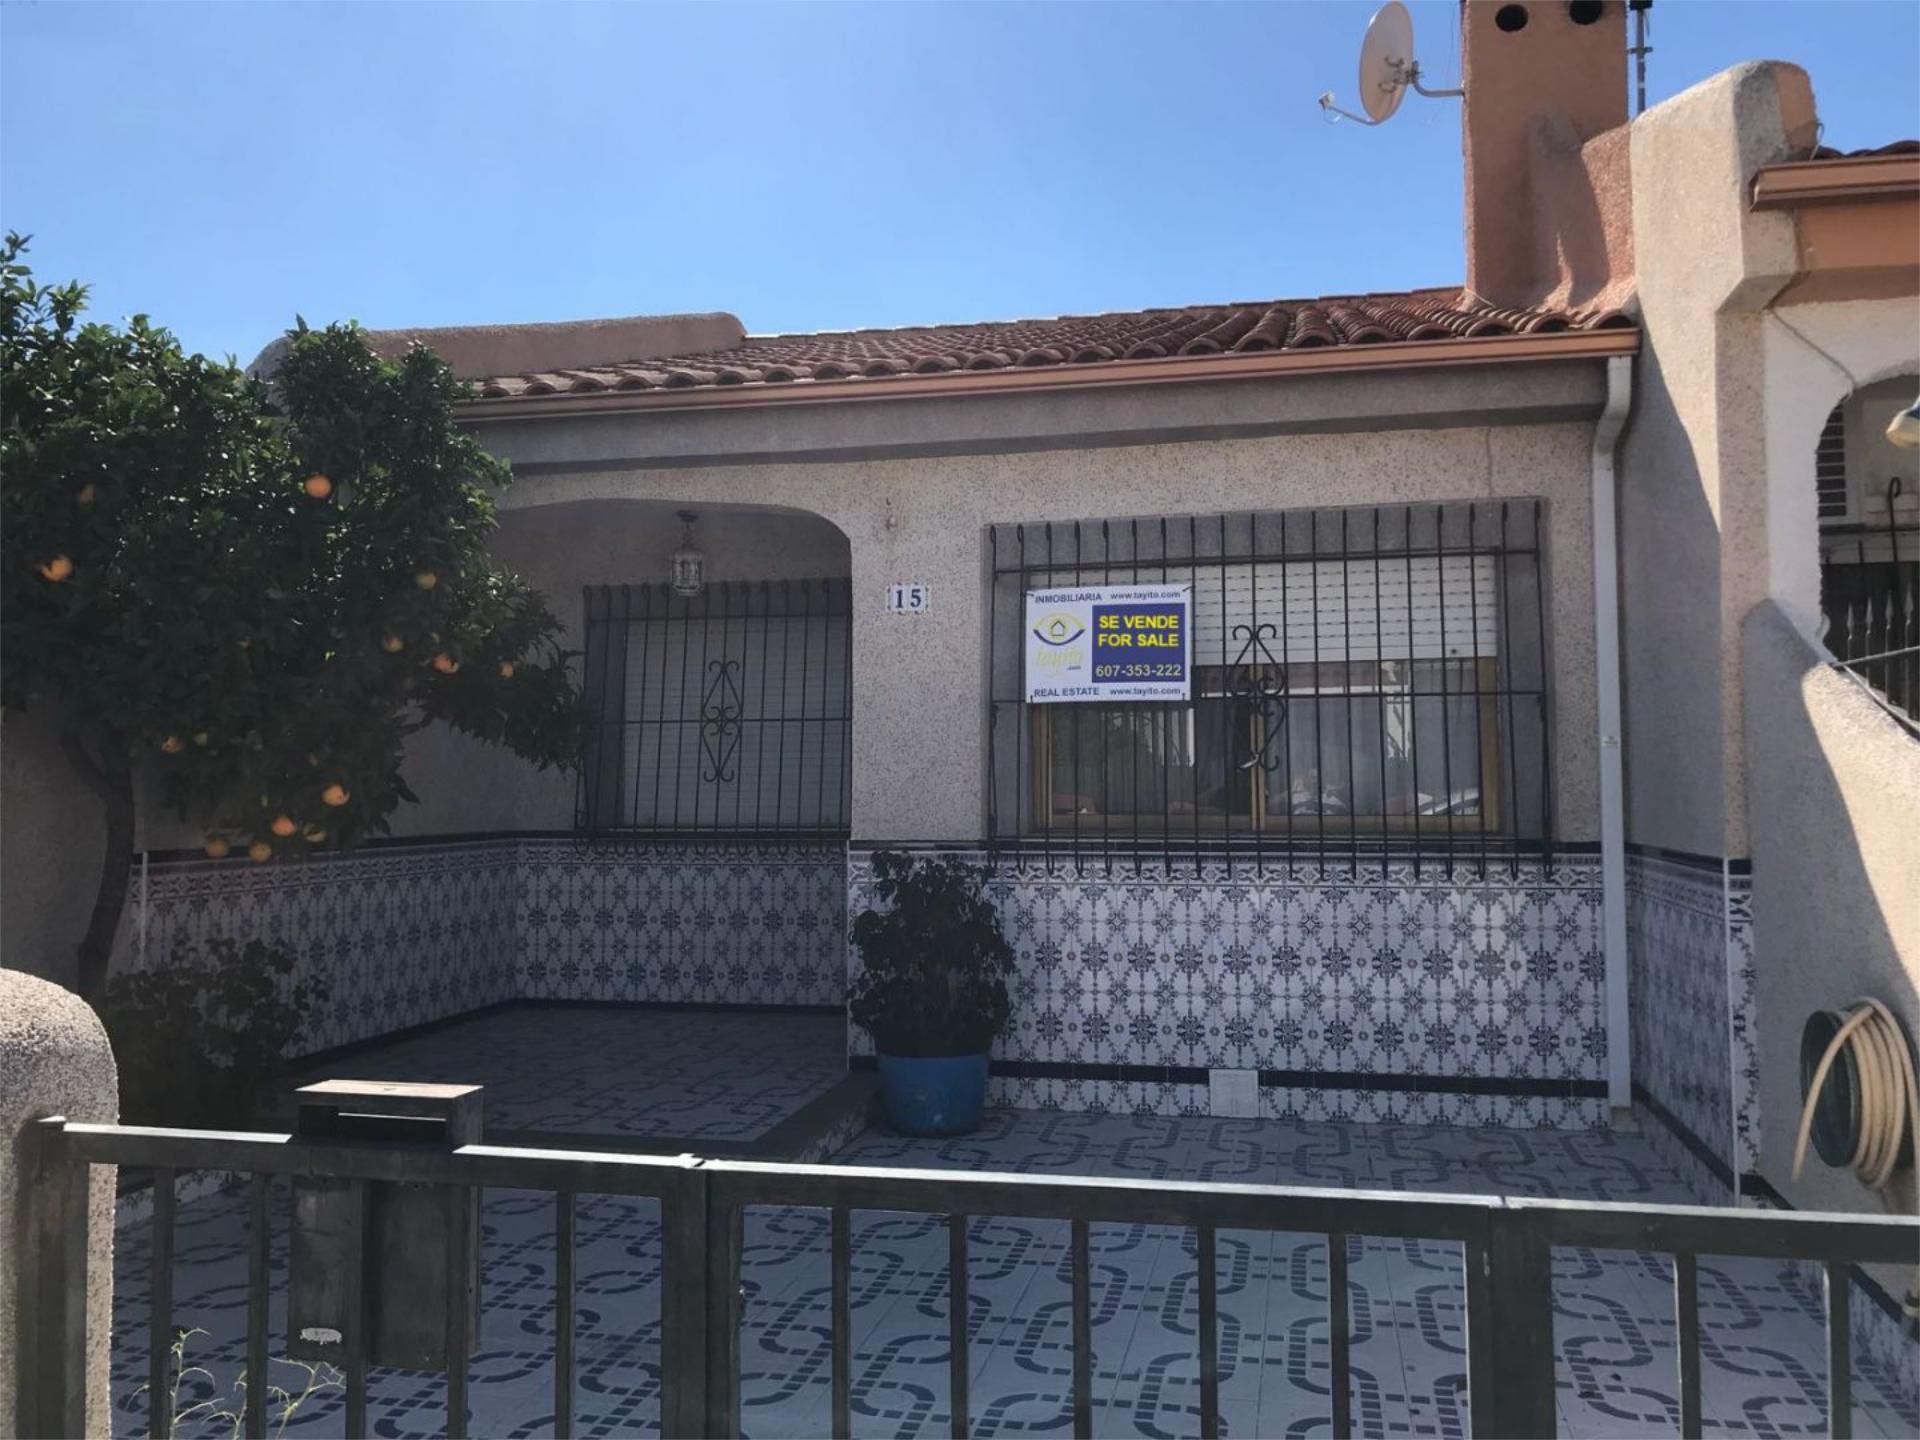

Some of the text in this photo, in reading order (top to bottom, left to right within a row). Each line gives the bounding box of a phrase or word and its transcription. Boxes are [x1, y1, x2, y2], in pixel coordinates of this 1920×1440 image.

[895, 589, 922, 608] 15
[1035, 592, 1102, 603] INMOBILIARIA
[1110, 591, 1181, 600] www.tayito.com
[1098, 615, 1179, 629] SE VENDE
[1098, 634, 1179, 647] FOR SALE
[1095, 664, 1181, 677] 607-353-222
[1034, 687, 1099, 697] REAL ESTATE
[1110, 687, 1181, 696] www.tayito.com
